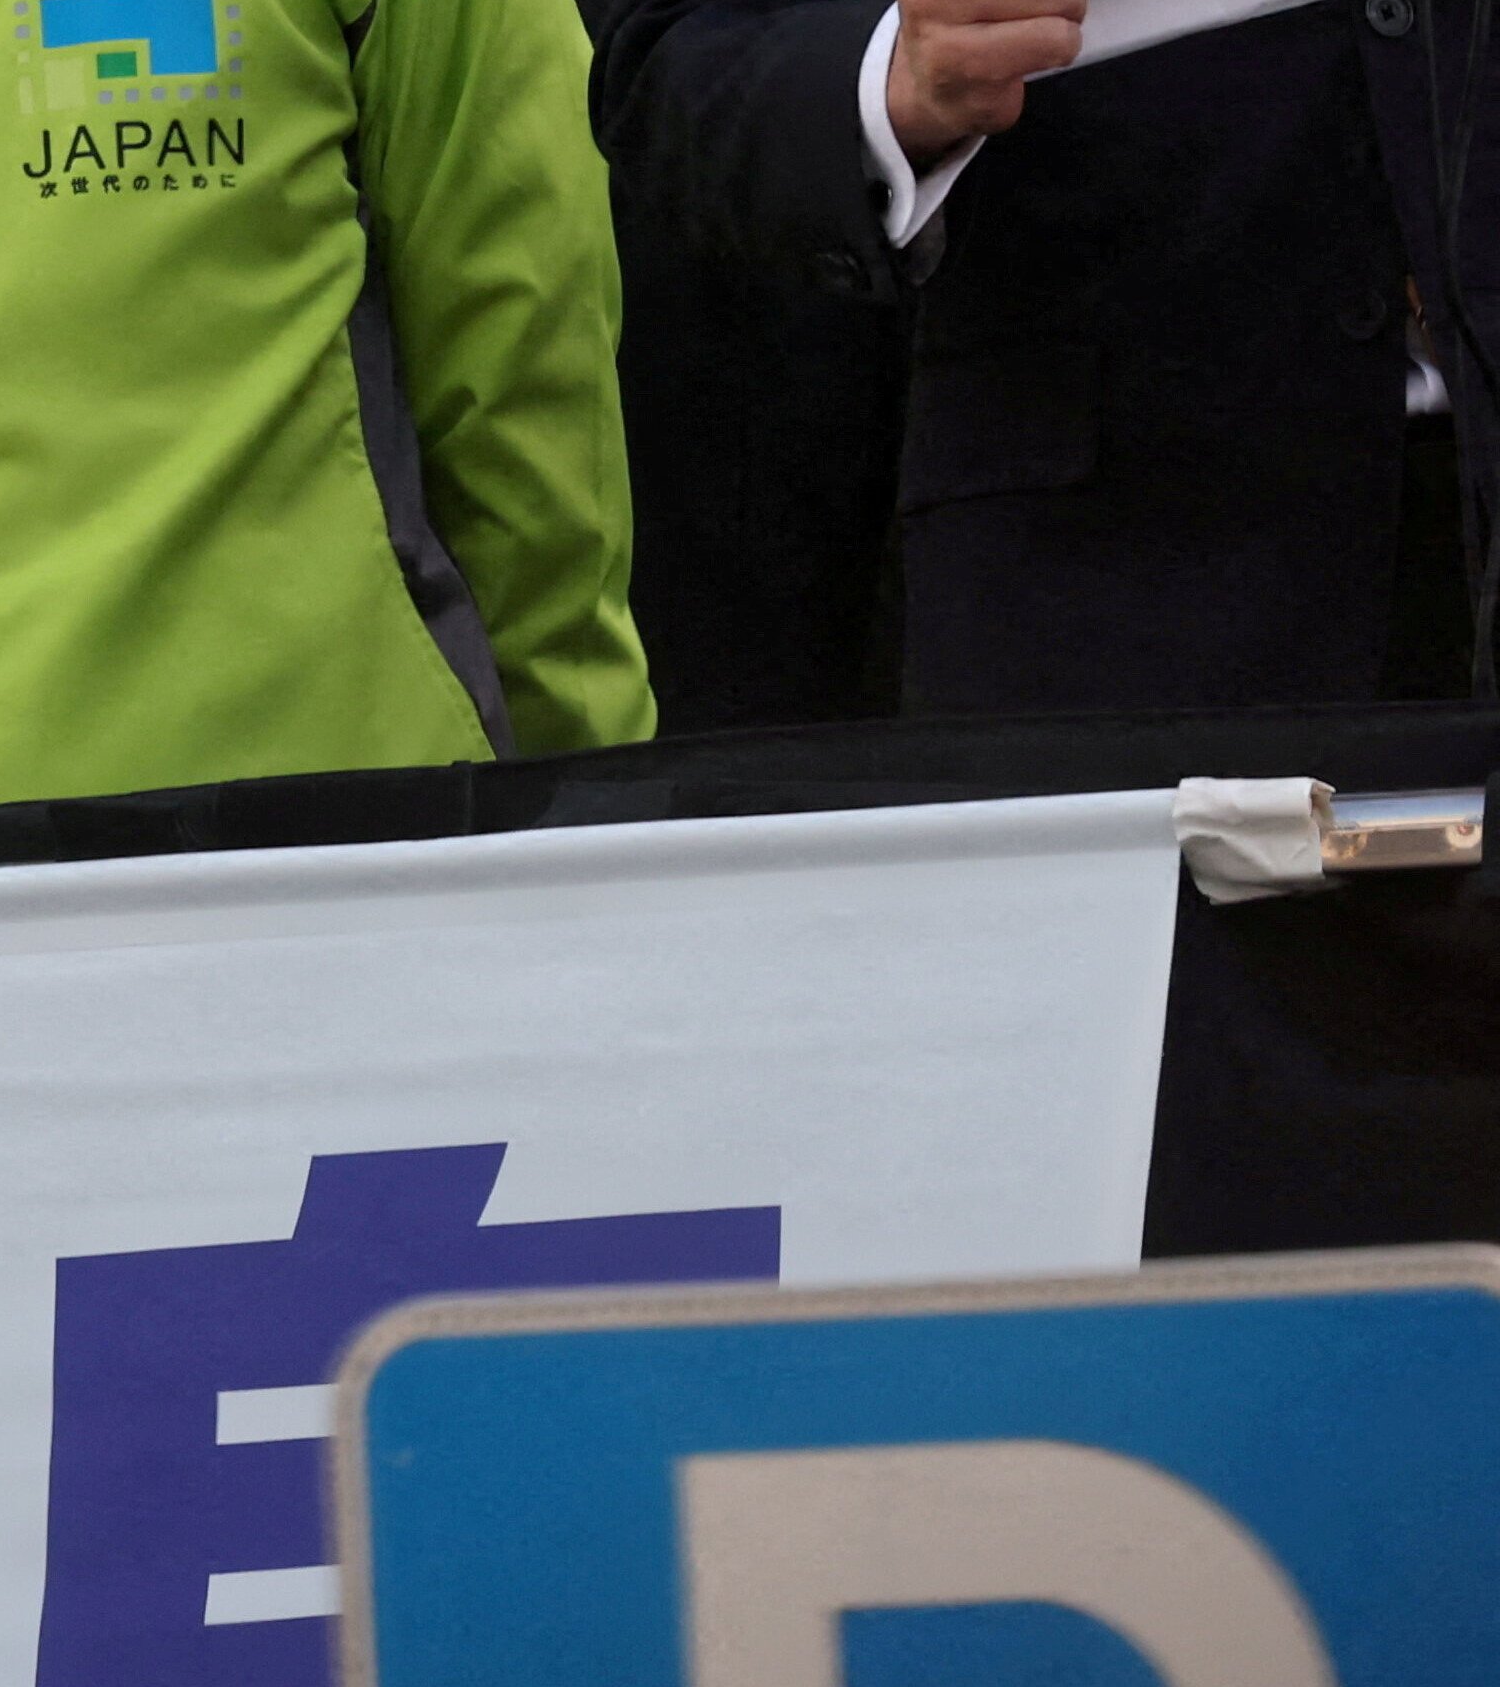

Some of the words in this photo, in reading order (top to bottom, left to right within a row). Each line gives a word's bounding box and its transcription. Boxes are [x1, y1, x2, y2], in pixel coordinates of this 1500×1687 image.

[22, 117, 245, 179] JAPAN
[39, 173, 237, 199] 次世代のために
